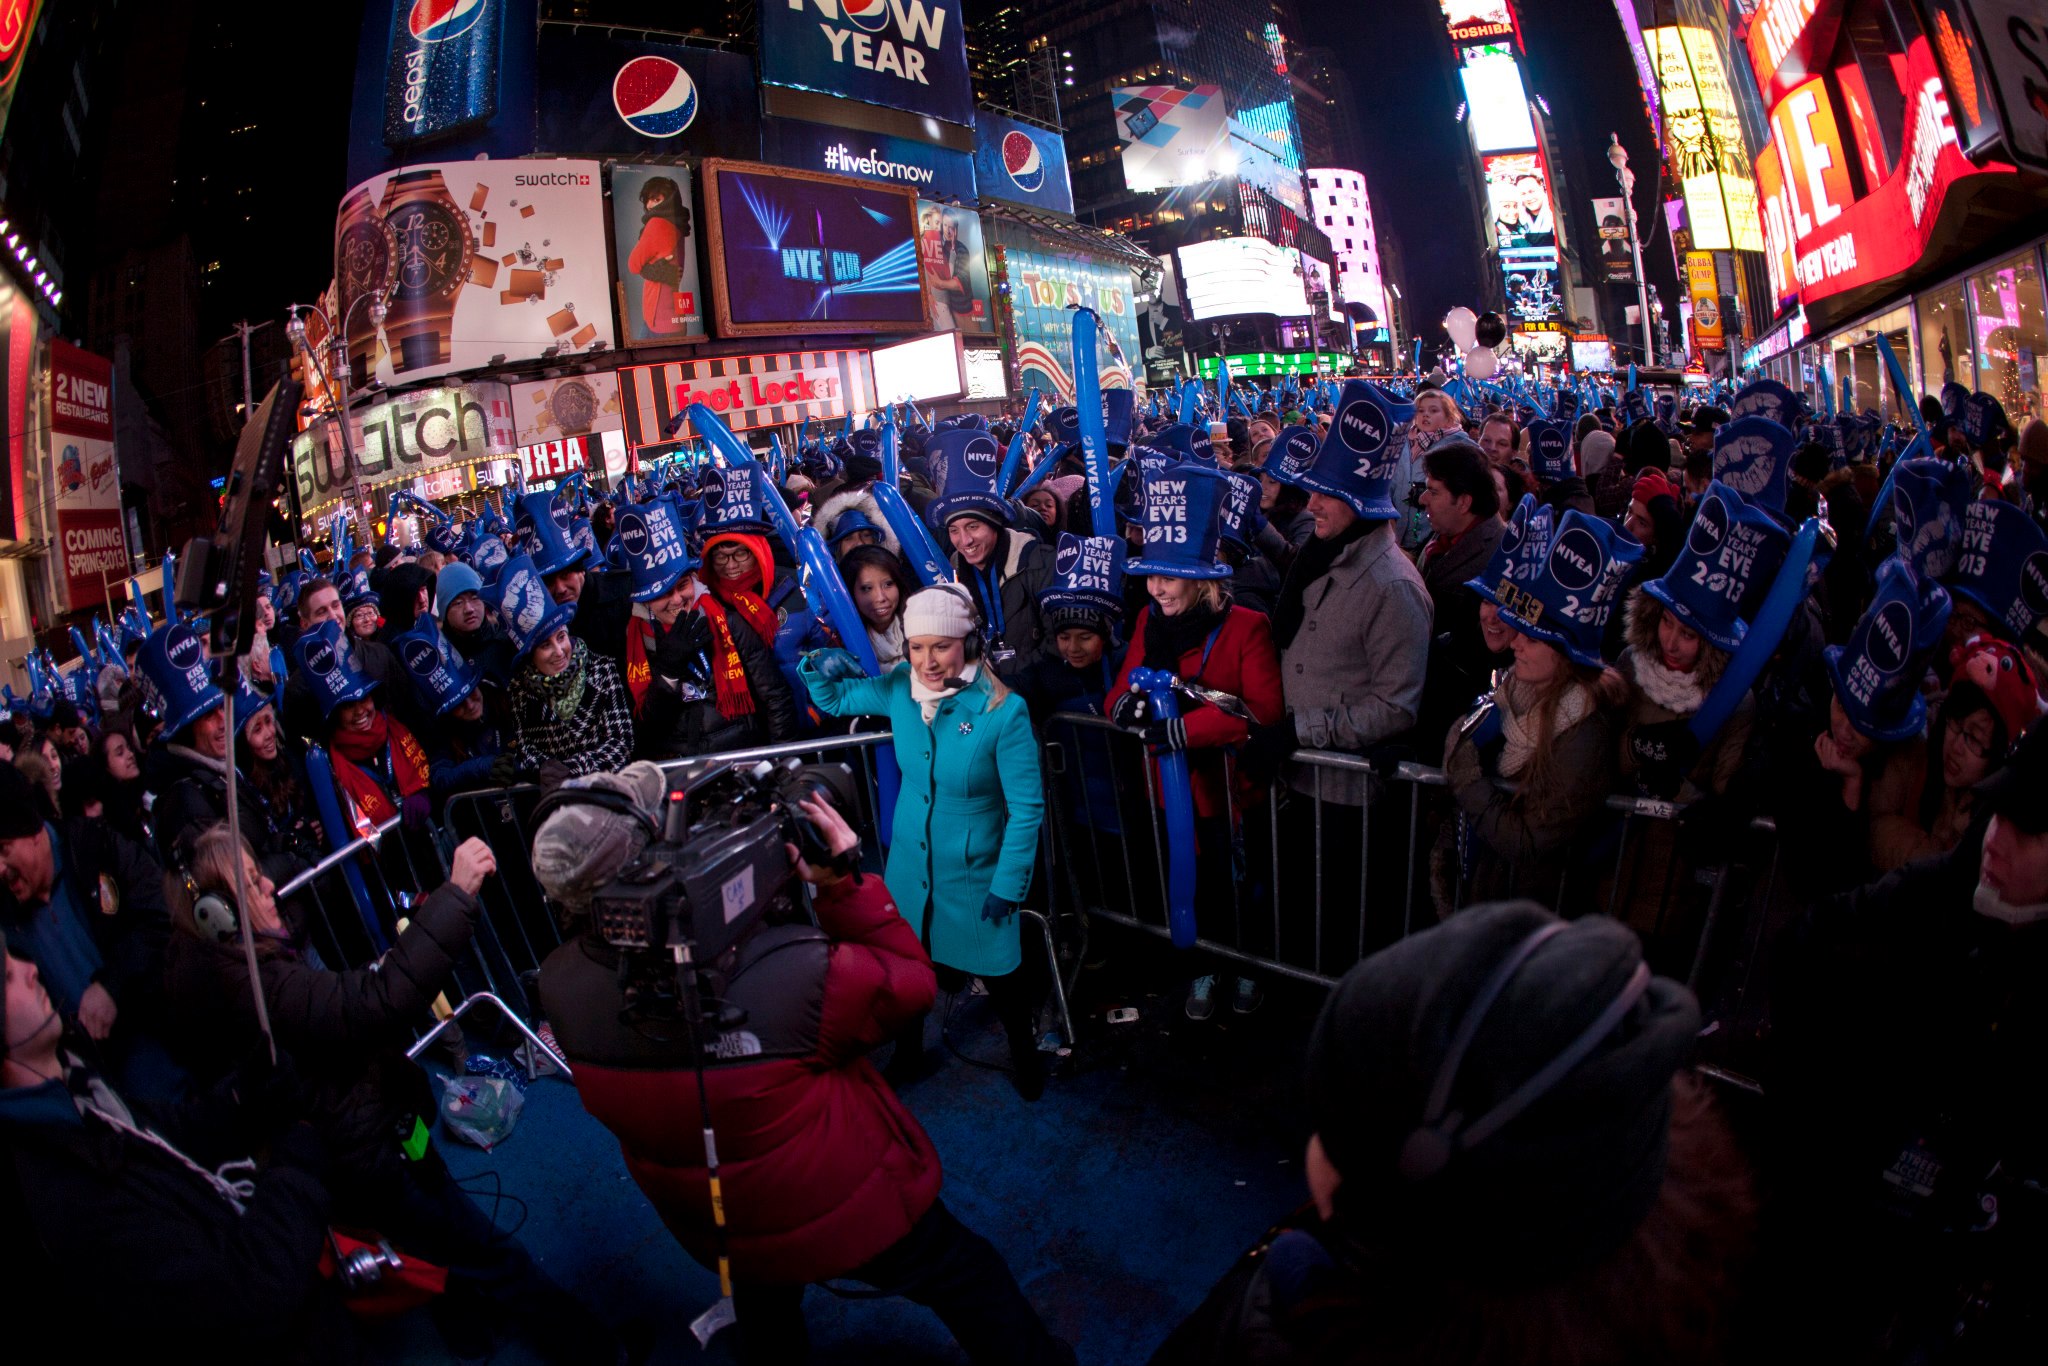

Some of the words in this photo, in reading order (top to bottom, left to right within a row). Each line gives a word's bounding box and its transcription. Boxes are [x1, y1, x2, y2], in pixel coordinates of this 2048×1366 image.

[1449, 24, 1514, 40] TOSHIBA
[819, 23, 929, 85] YEAR
[403, 50, 426, 123] pepsi
[824, 143, 933, 183] #livefornow
[515, 172, 578, 186] swatch
[782, 249, 823, 282] NYE
[832, 252, 861, 281] CLUB
[1687, 256, 1712, 267] BUBBA
[1691, 269, 1712, 280] GUMP
[1022, 271, 1082, 309] TOYS
[1099, 288, 1125, 315] US
[678, 299, 690, 309] GAP
[1524, 322, 1537, 331] FOR
[56, 373, 68, 399] 2
[71, 376, 109, 409] NEW
[675, 379, 745, 413] Foot
[751, 371, 841, 407] Locker
[55, 400, 110, 425] RESTAURANTS
[1343, 412, 1381, 442] NIVEA
[295, 392, 491, 505] swatch
[1290, 438, 1312, 453] NIVEA
[1541, 440, 1563, 448] NIVEA
[967, 452, 997, 463] NIVEA
[1141, 458, 1167, 469] NEW
[1283, 456, 1300, 469] KISS
[727, 469, 751, 482] NEW
[1085, 449, 1101, 498] NIVEA
[1302, 476, 1320, 488] HAPPY
[705, 484, 723, 494] NIVEA
[727, 481, 752, 490] YEAR'S
[1149, 481, 1187, 496] NEW
[1228, 475, 1254, 494] NEW
[727, 489, 751, 504] EVE
[951, 496, 971, 504] HAPPY
[1150, 496, 1187, 505] YEAR'S
[1231, 489, 1249, 504] EAR'S
[645, 506, 668, 525] NEW
[716, 505, 754, 522] 2013
[1150, 506, 1187, 522] EVE
[1230, 498, 1247, 516] VE
[1966, 502, 2000, 522] NEW
[649, 518, 672, 532] YEAR'S
[1530, 515, 1548, 530] NEW
[1695, 512, 1720, 541] NIVEA
[1965, 518, 1996, 534] YEAR'S
[65, 528, 123, 552] COMING
[622, 530, 646, 541] NIVEA
[651, 527, 677, 548] EVE
[1527, 531, 1549, 541] YEAR'S
[1729, 520, 1768, 546] NEW
[1962, 530, 1993, 553] EVE
[1085, 537, 1115, 551] NEW
[1521, 542, 1547, 559] EVE
[1727, 536, 1758, 558] YEAR'S
[643, 541, 683, 570] 2013
[1057, 546, 1078, 561] NIVEA
[1084, 547, 1112, 561] YEAR'S
[1555, 542, 1593, 577] NIVEA
[68, 553, 101, 578] SPRING
[102, 549, 126, 573] 2013
[1083, 558, 1110, 575] EVE
[1153, 565, 1180, 573] SQUARE
[1718, 546, 1753, 580] EVE
[1067, 573, 1110, 592] 2013
[1691, 560, 1745, 603] 2013
[1051, 605, 1099, 623] PARIS
[1559, 595, 1610, 627] 2013
[2013, 596, 2033, 625] KISS
[1517, 618, 1532, 628] NEW
[1533, 626, 1552, 635] YEAR
[1875, 612, 1903, 661] NIVEA
[168, 635, 198, 660] NIVEA
[309, 644, 333, 668] NIVEA
[409, 646, 434, 669] NIVEA
[186, 664, 206, 681] KISS
[324, 667, 342, 684] KISS
[428, 666, 446, 684] KISS
[1856, 654, 1881, 687] KISS
[331, 678, 350, 696] YEAR
[436, 677, 454, 695] YEAR
[1846, 676, 1870, 706] YEAR
